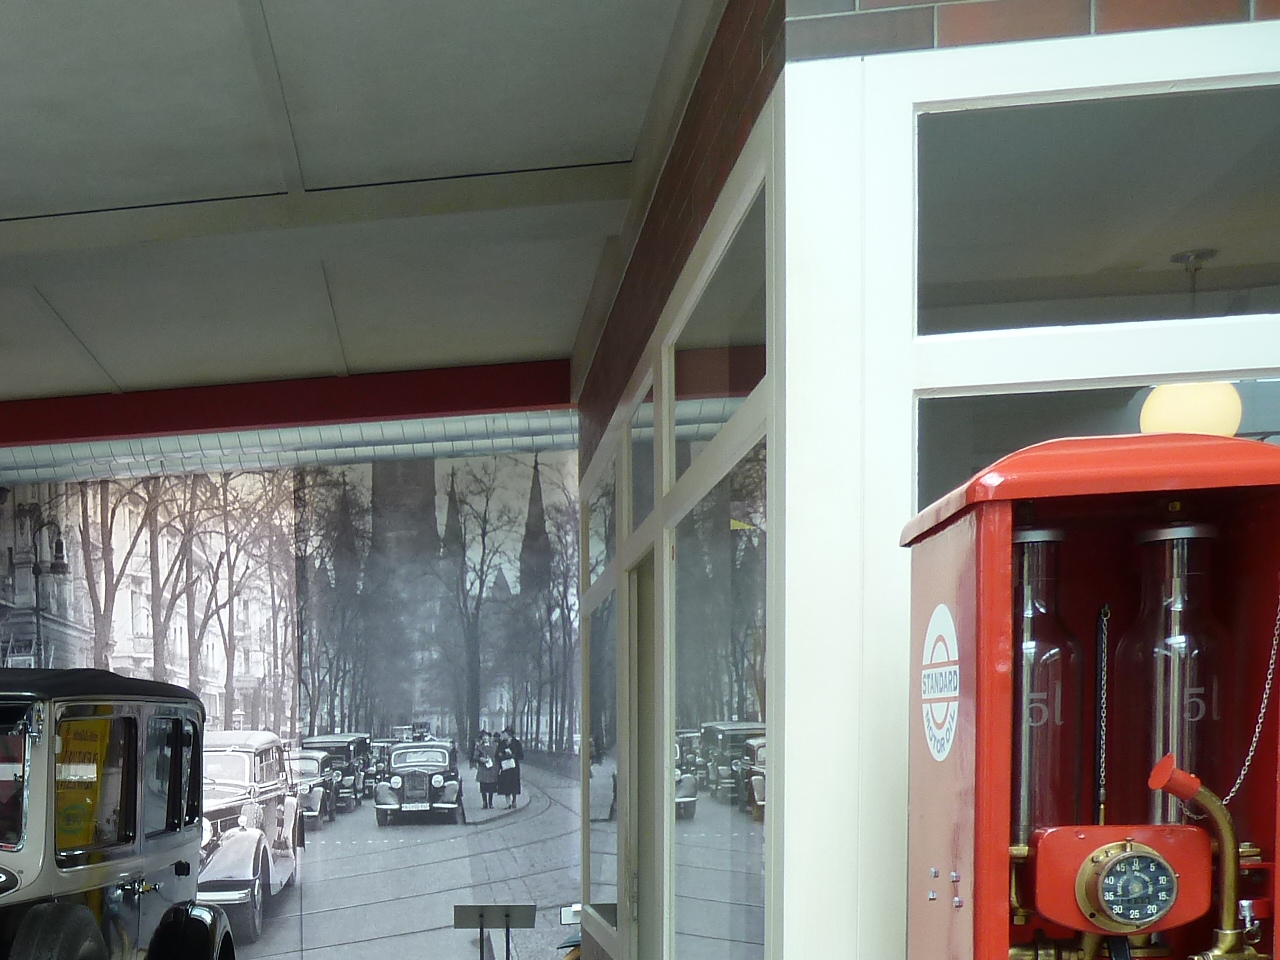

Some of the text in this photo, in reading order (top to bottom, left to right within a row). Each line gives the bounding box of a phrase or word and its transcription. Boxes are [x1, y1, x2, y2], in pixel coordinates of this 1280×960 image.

[922, 669, 958, 696] STANDARD
[925, 708, 957, 754] MOTOR OIL
[1115, 863, 1125, 872] 45
[1150, 863, 1155, 871] 5
[1104, 876, 1114, 885] 40
[1158, 876, 1167, 885] 10
[1104, 892, 1114, 900] 35
[1158, 892, 1166, 900] 15
[1112, 905, 1123, 914] 30
[1147, 905, 1157, 914] 20
[1129, 910, 1140, 919] 25
